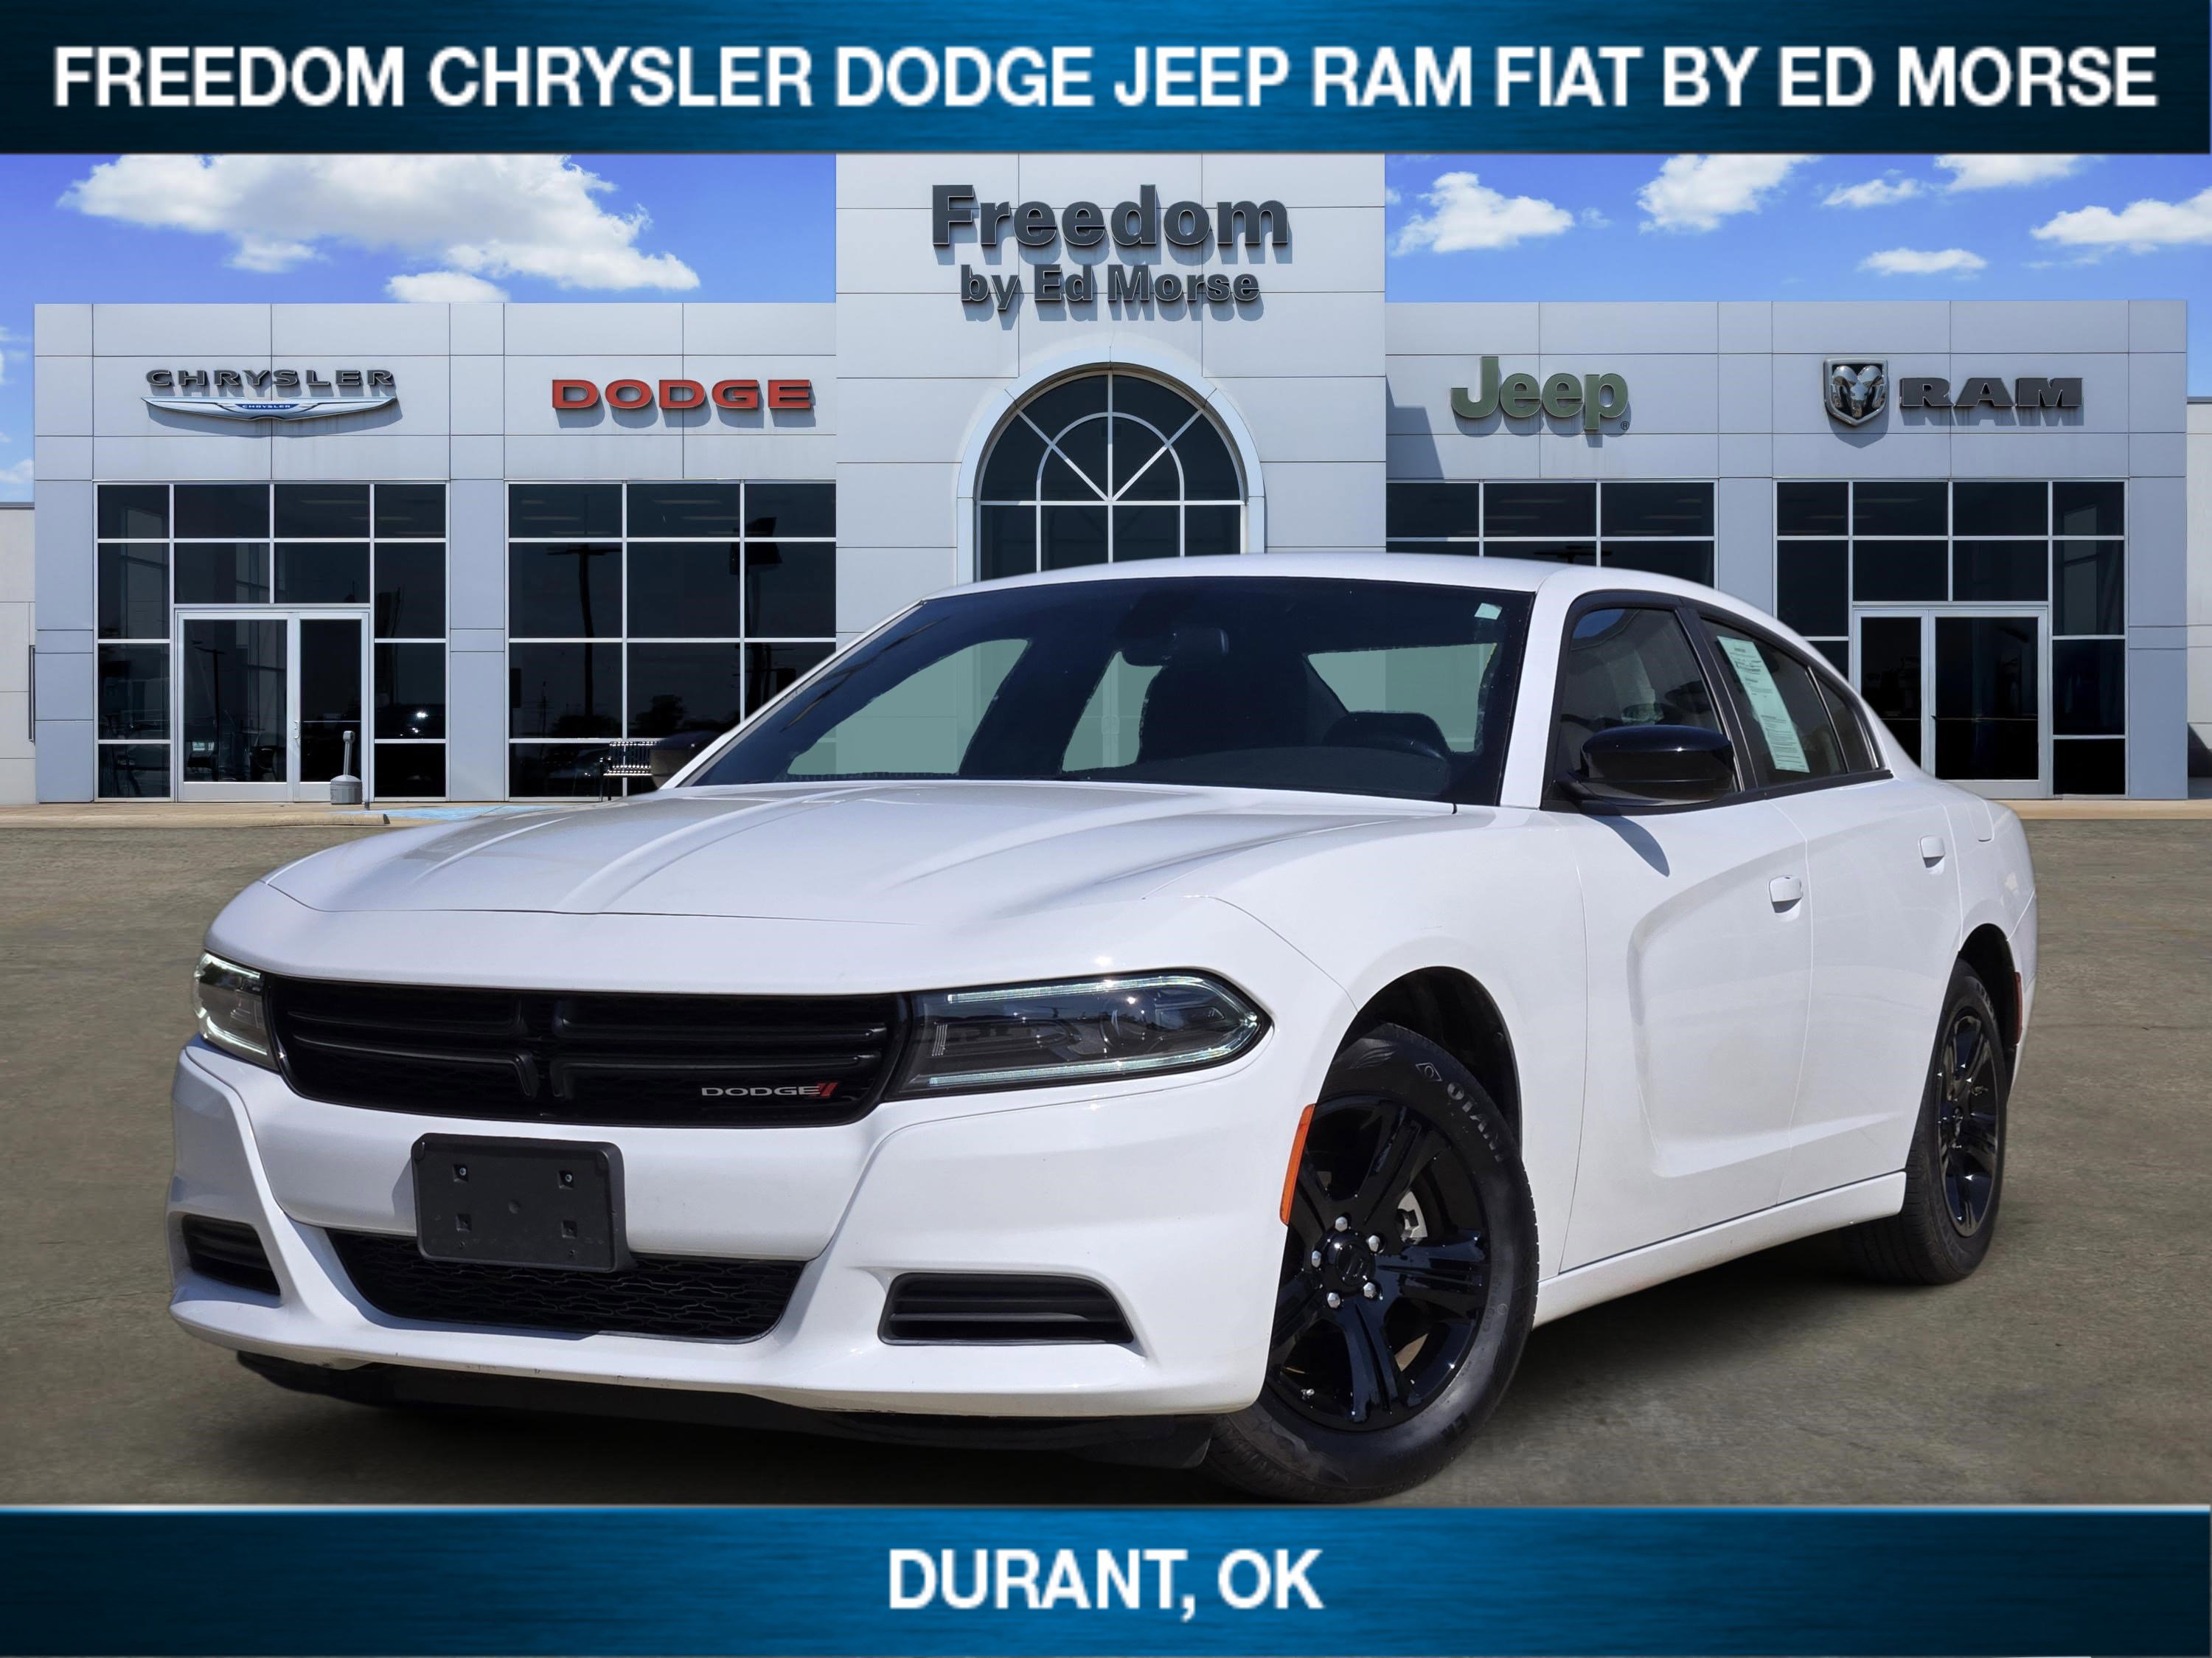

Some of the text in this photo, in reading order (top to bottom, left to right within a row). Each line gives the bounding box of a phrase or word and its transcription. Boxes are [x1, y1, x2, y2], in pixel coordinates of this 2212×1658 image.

[932, 184, 1289, 246] Freedom
[961, 264, 1260, 311] by Ed Morse
[146, 369, 394, 386] CHRYSLER
[1450, 355, 1629, 430] Jeep
[1899, 377, 2083, 407] RAM
[552, 378, 811, 409] DODGE
[701, 1086, 821, 1096] DODGE
